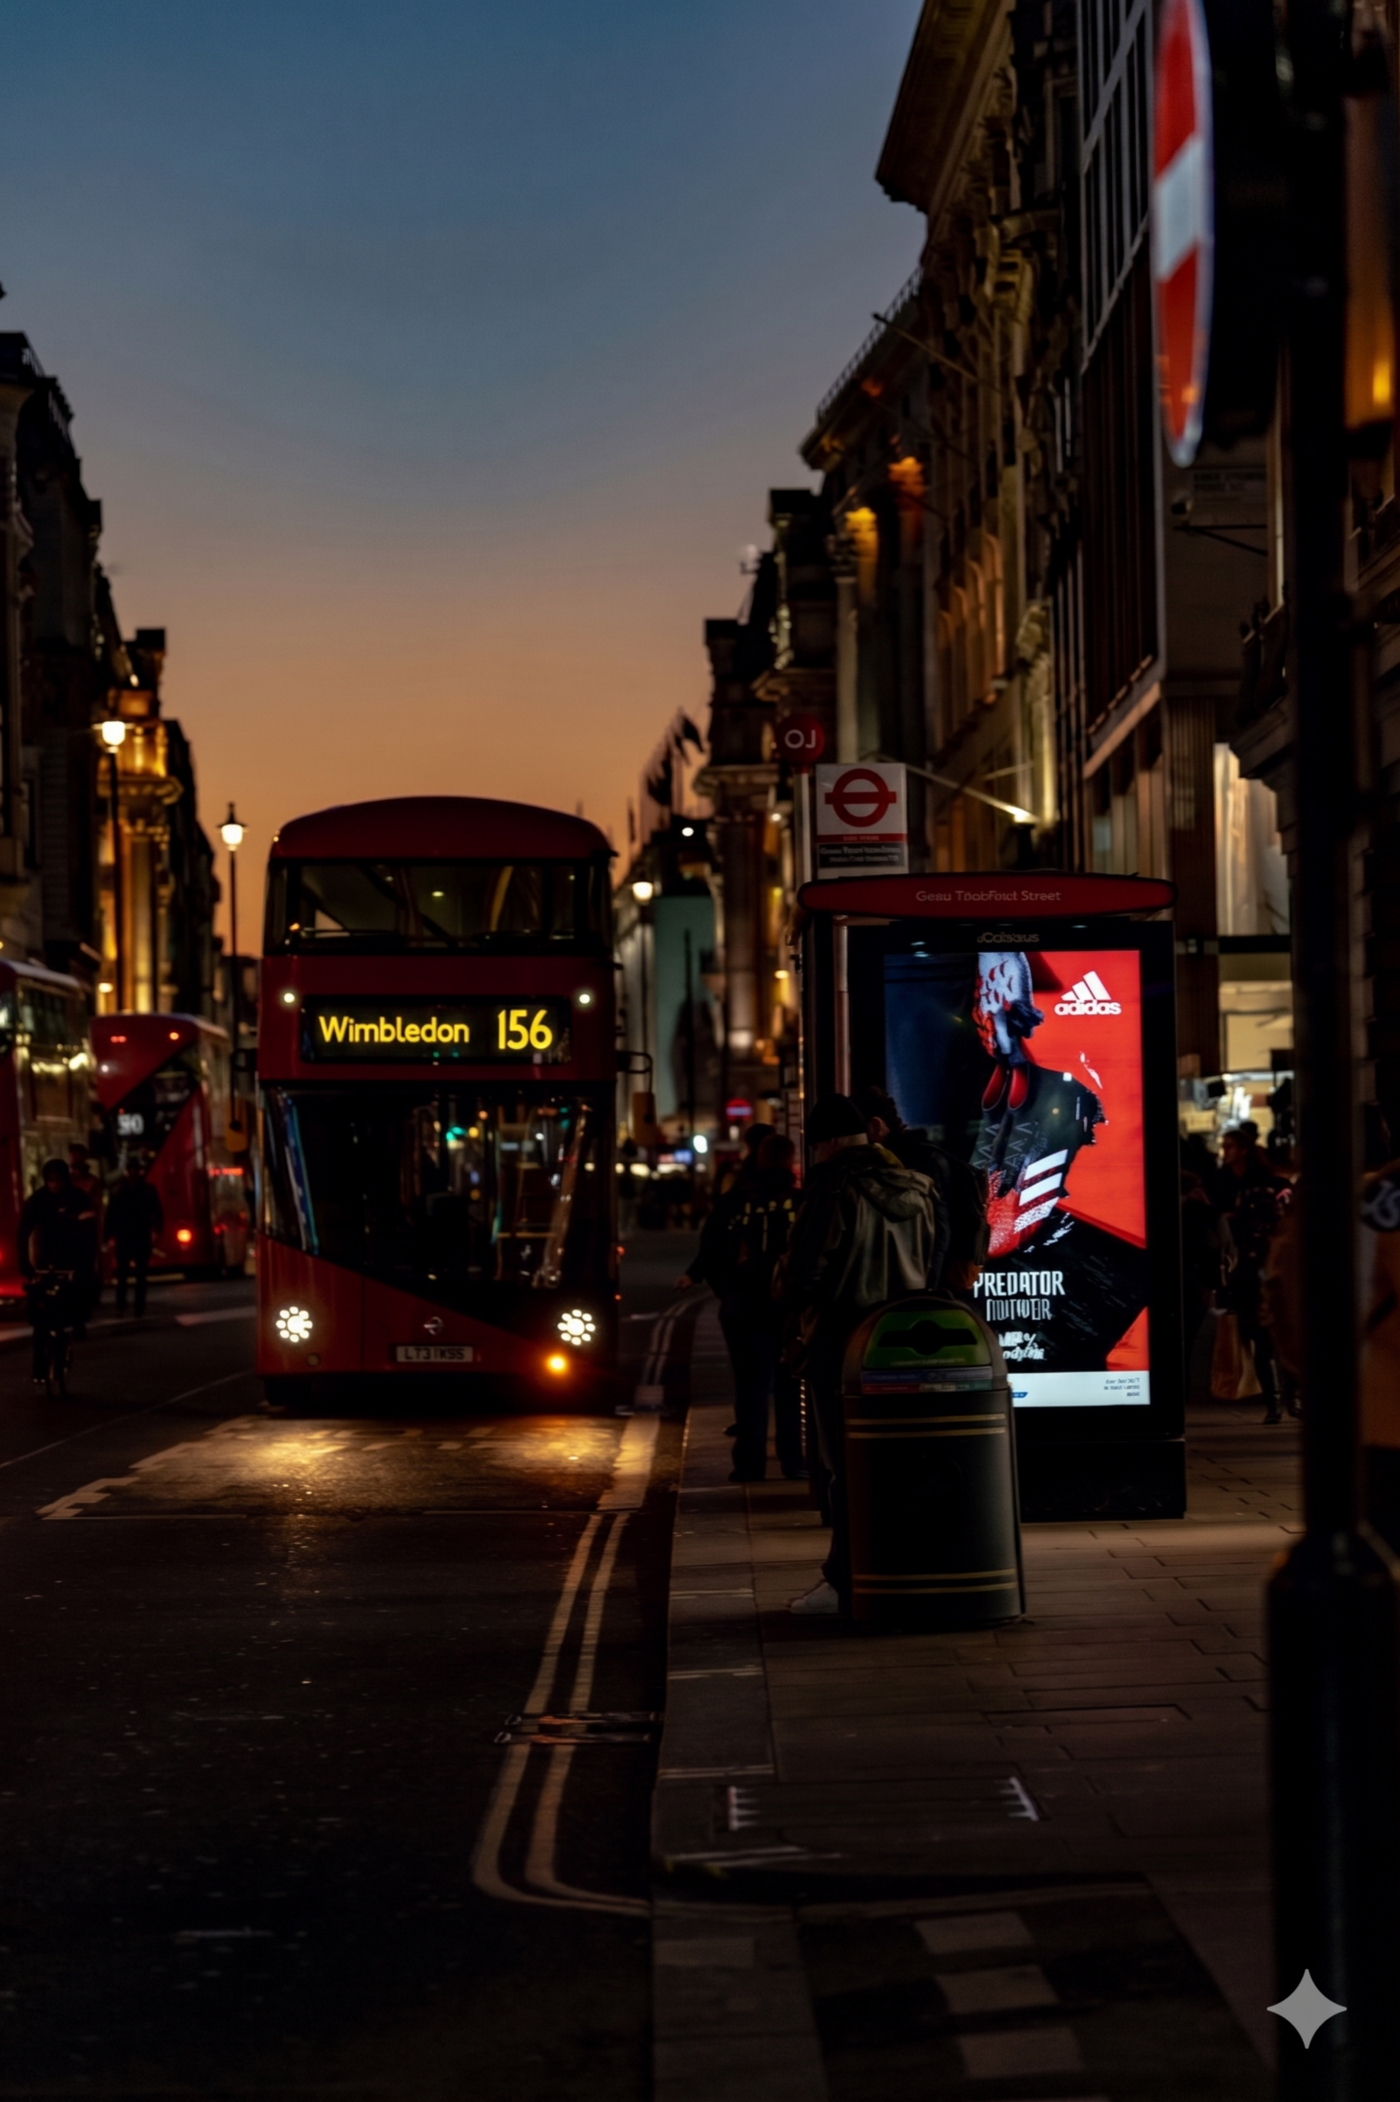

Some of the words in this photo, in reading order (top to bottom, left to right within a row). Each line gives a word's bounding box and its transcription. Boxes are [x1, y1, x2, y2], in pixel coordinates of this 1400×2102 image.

[1021, 889, 1063, 902] Street
[1053, 1000, 1122, 1016] adidas
[318, 1015, 471, 1044] Wimbledon
[497, 1008, 554, 1051] 156
[973, 1270, 1066, 1299] PREDATOR
